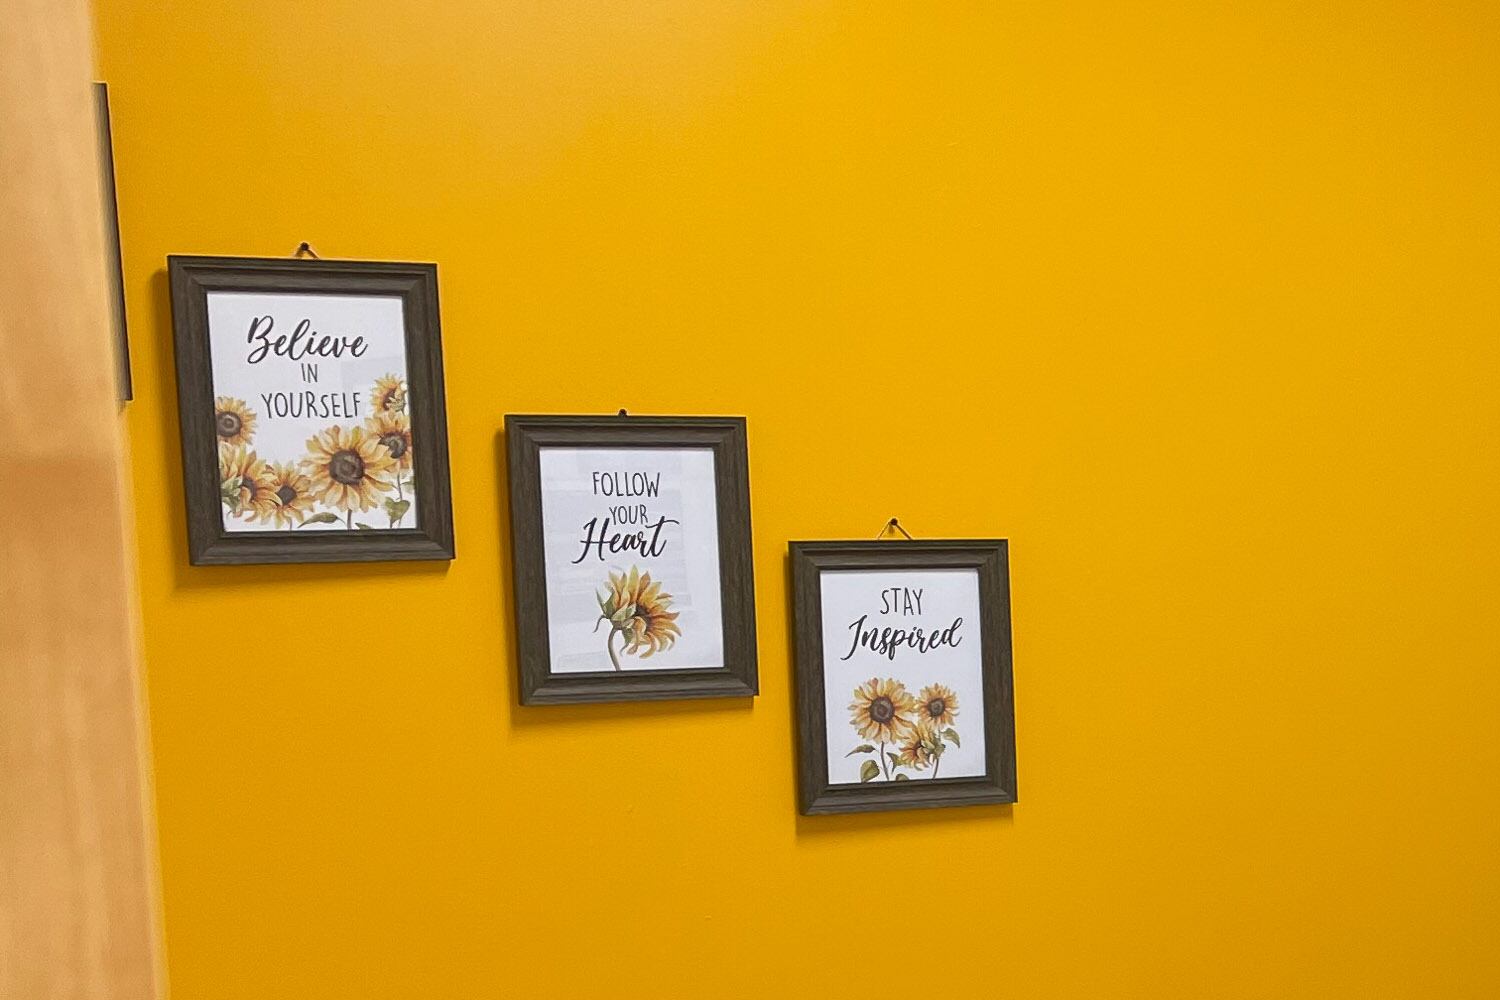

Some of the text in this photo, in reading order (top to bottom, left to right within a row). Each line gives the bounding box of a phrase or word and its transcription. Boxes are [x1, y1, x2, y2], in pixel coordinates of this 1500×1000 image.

[247, 315, 368, 364] Believe
[301, 363, 318, 383] IN
[261, 391, 360, 419] YOURSELF
[593, 471, 660, 497] FOLLOW
[609, 504, 648, 525] YOUR
[571, 515, 680, 564] Heart
[880, 587, 923, 616] STAY
[840, 615, 963, 661] Inspired
